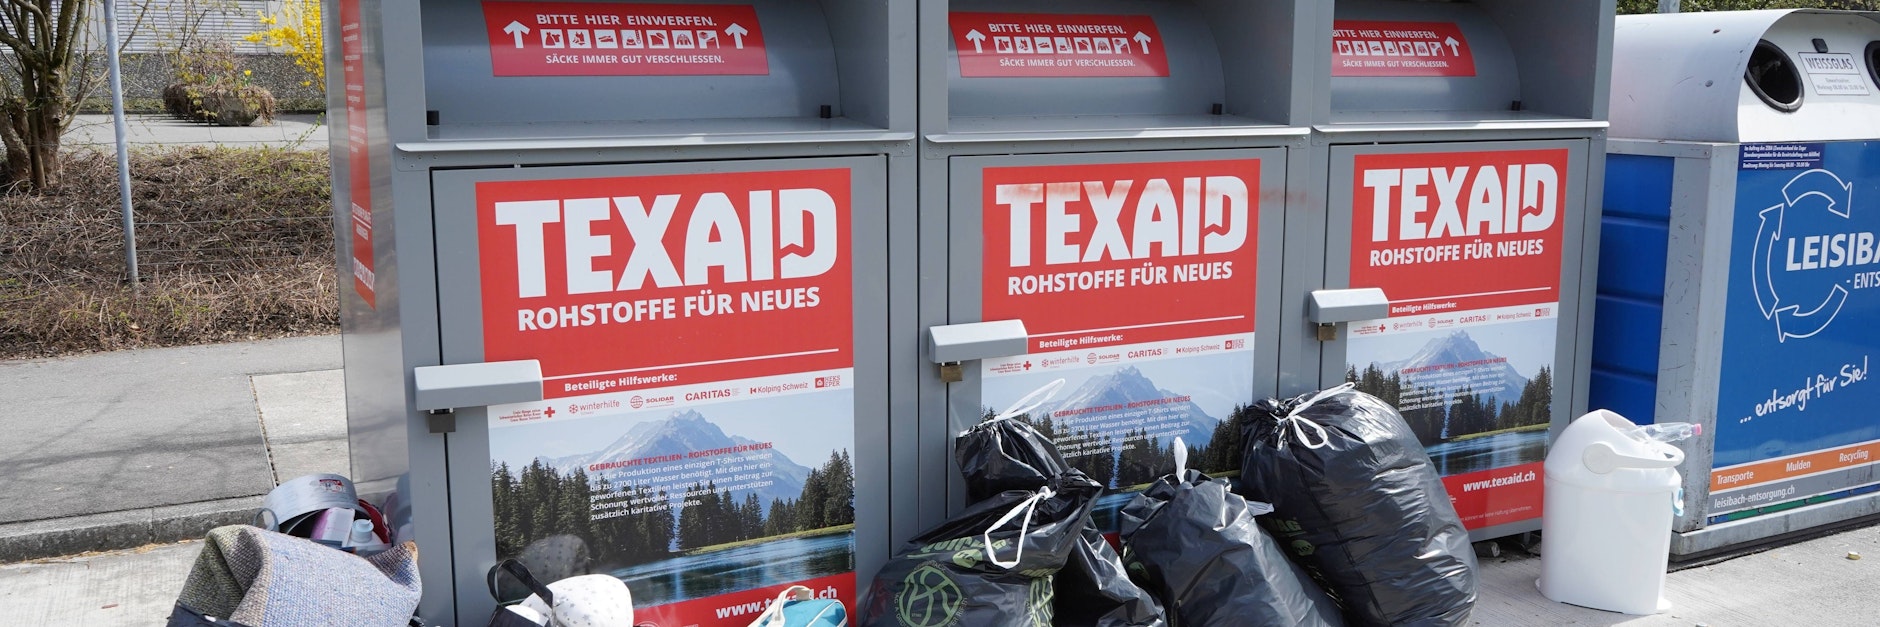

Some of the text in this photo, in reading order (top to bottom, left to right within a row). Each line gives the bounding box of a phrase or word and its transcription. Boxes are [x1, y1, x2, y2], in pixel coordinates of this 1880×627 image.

[536, 14, 718, 27] BITTE HIER EINWERFEN.
[988, 23, 1127, 34] BITTE HIER EINWERFEN.
[1358, 30, 1382, 38] HIER
[1383, 30, 1439, 39] EINWERFEN.
[546, 53, 724, 64] SÄCKE IMMER GUT VERSCHLIESSEN.
[1000, 58, 1136, 67] SÄCKE IMMER GUT VERSCHLIESSEN.
[1342, 60, 1362, 68] SÄCKE
[1364, 60, 1386, 68] IMMER
[1387, 60, 1400, 68] GUT
[1804, 57, 1854, 70] WEISSGLAS
[1364, 163, 1558, 242] TEXAID
[996, 176, 1248, 267] TEXAID
[495, 188, 837, 298] TEXAID
[1370, 238, 1544, 267] ROHSTOFFE FÜR NEUES
[1008, 261, 1233, 296] ROHSTOFFE FÜR NEUES
[518, 286, 820, 331] ROHSTOFFE FÜR NEUES
[1392, 302, 1457, 314] Beteiligte Hilfswerke:
[1460, 315, 1486, 324] CARITAS
[1039, 334, 1123, 348] Beteiligte Hilfswerke:
[1128, 348, 1162, 359] CARITAS
[564, 373, 677, 392] Beteiligte Hilfswerke:
[758, 381, 808, 396] Kolping Schweiz
[1755, 375, 1813, 418] entsorgt
[1812, 375, 1837, 399] für
[1840, 355, 1868, 388] Sie!
[580, 399, 620, 411] winterhilfe
[646, 396, 674, 404] SOLIDAR
[685, 388, 731, 402] CARITAS
[590, 458, 642, 471] GEBRAUCHTE
[643, 453, 681, 464] TEXTILIEN
[689, 446, 731, 458] ROHSTOFFE
[733, 444, 748, 452] FÜR
[749, 441, 772, 450] NEUES
[618, 467, 660, 477] Produktion
[662, 464, 682, 472] eines
[684, 460, 715, 469] einzigen
[716, 456, 744, 465] T-Shirts
[745, 452, 772, 461] werden
[1717, 449, 1869, 485] Transporte Mulden Recycling
[590, 483, 601, 491] bis
[612, 479, 631, 488] 2700
[652, 474, 680, 483] Wasser
[681, 470, 712, 479] benötigt.
[590, 490, 636, 502] geworfenen
[638, 485, 671, 494] Textilien
[672, 482, 697, 490] leisten
[711, 477, 732, 485] einen
[734, 474, 760, 482] Beitrag
[1463, 470, 1536, 492] www.texaid.ch
[590, 481, 773, 511] Schonung wertvoller Ressourcen und unterstützen
[1714, 484, 1796, 510] leisibach-entsorgung.ch
[590, 499, 702, 520] zusätzlich karitative Projekte.
[716, 586, 838, 619] www.td.ch
